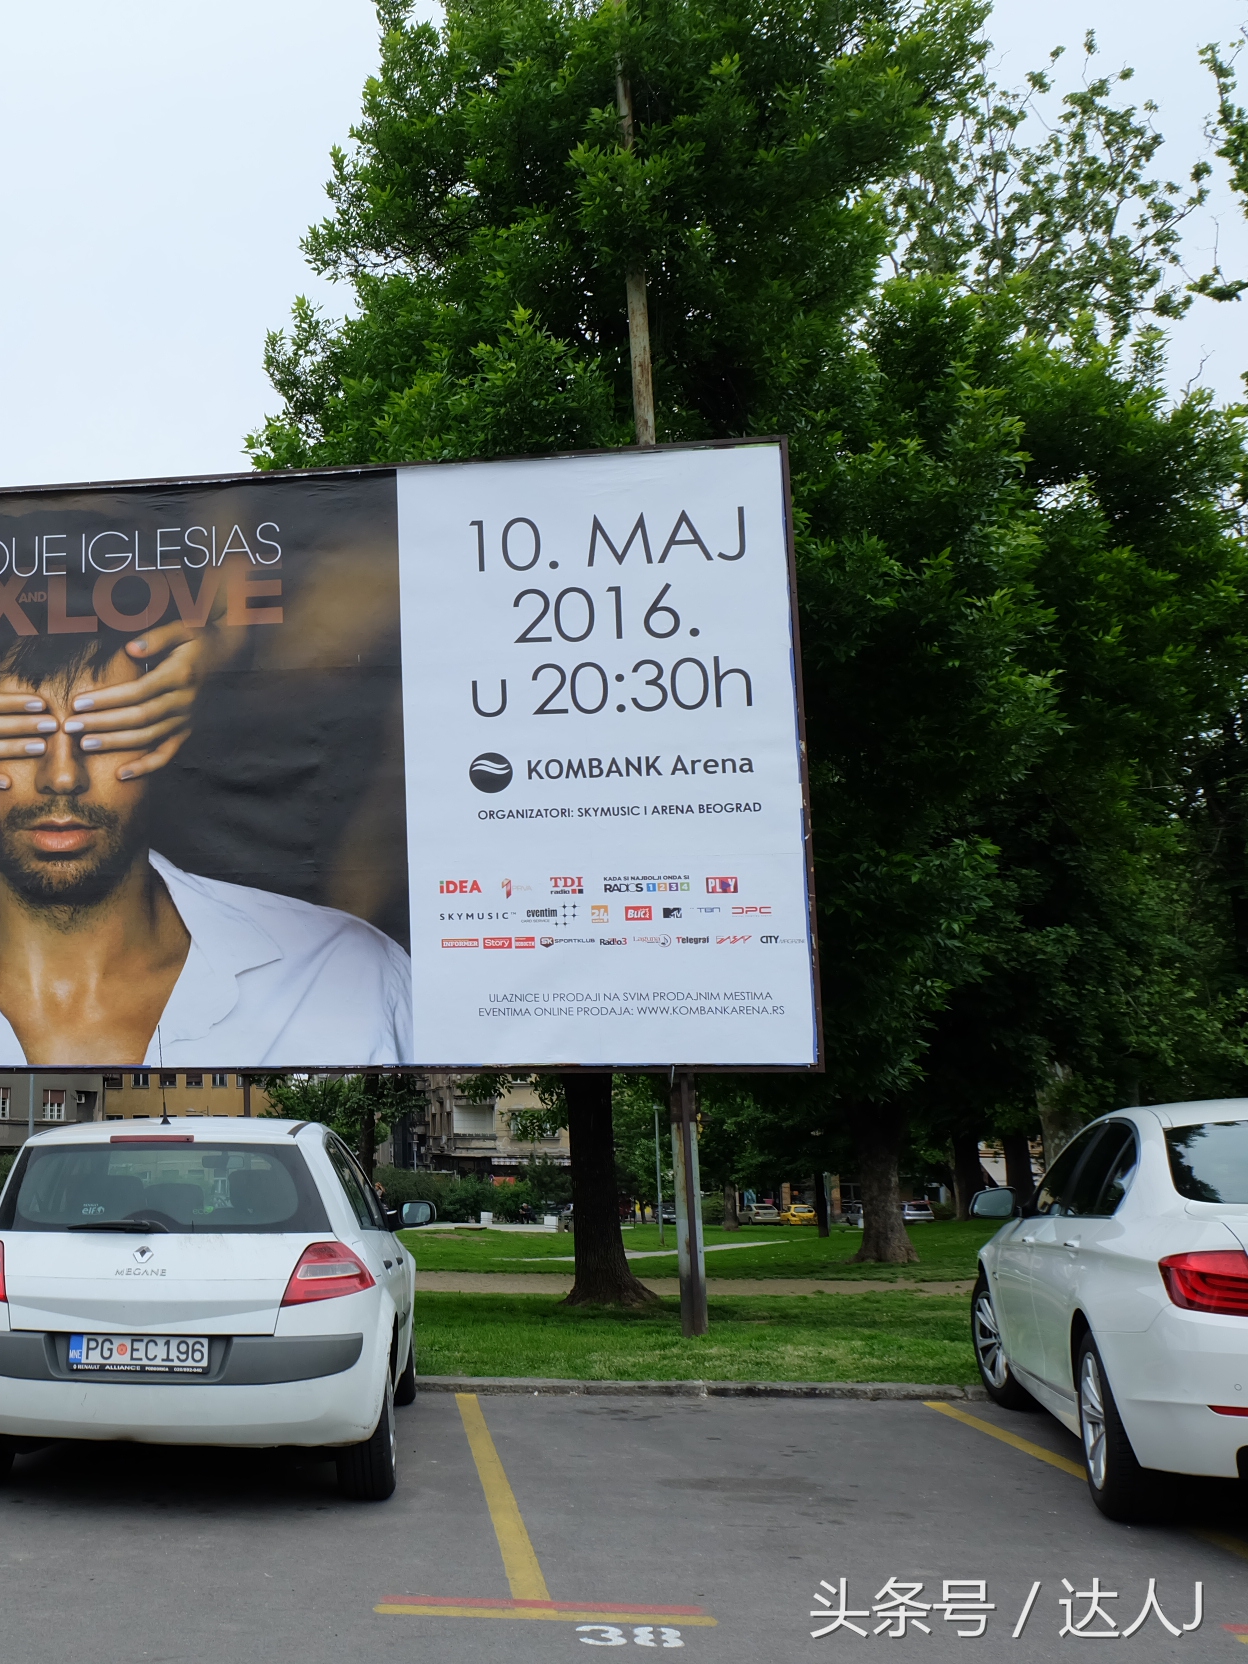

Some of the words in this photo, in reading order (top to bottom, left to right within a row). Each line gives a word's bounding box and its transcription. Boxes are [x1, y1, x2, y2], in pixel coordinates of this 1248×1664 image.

[81, 522, 282, 573] IGLESIAS
[469, 517, 559, 572] 10.
[587, 506, 746, 567] MAJ
[19, 591, 47, 604] AND
[48, 555, 284, 634] LOVE
[513, 582, 700, 643] 2016.
[531, 655, 753, 716] 20:30h
[527, 755, 663, 780] KOMBANK
[670, 754, 755, 776] Arena
[478, 808, 574, 820] ORGANIZATORI:
[577, 805, 641, 818] SKYMUSIC
[651, 803, 695, 815] ARENA
[698, 801, 762, 815] BEOGRAD
[550, 876, 584, 888] TDI
[526, 908, 558, 918] eventim
[485, 939, 510, 948] Story
[676, 936, 710, 945] Telegraf
[760, 935, 779, 944] CITY
[489, 993, 540, 1003] ULAZNICE
[542, 993, 550, 1002] U
[552, 992, 601, 1002] PRODAJI
[603, 992, 621, 1002] NA
[622, 991, 650, 1002] SVIM
[652, 991, 721, 1001] PRODAJNIM
[723, 991, 774, 1001] MESTIMA
[478, 1007, 532, 1017] EVENTIMA
[534, 1006, 575, 1017] ONLINE
[576, 1006, 634, 1016] PRODAJA:
[637, 1005, 785, 1016] WWW.KOMBANKARENA.RS
[69, 1350, 82, 1359] MNE
[85, 1337, 114, 1360] PG
[130, 1338, 205, 1363] EC196
[575, 1625, 686, 1648] 38
